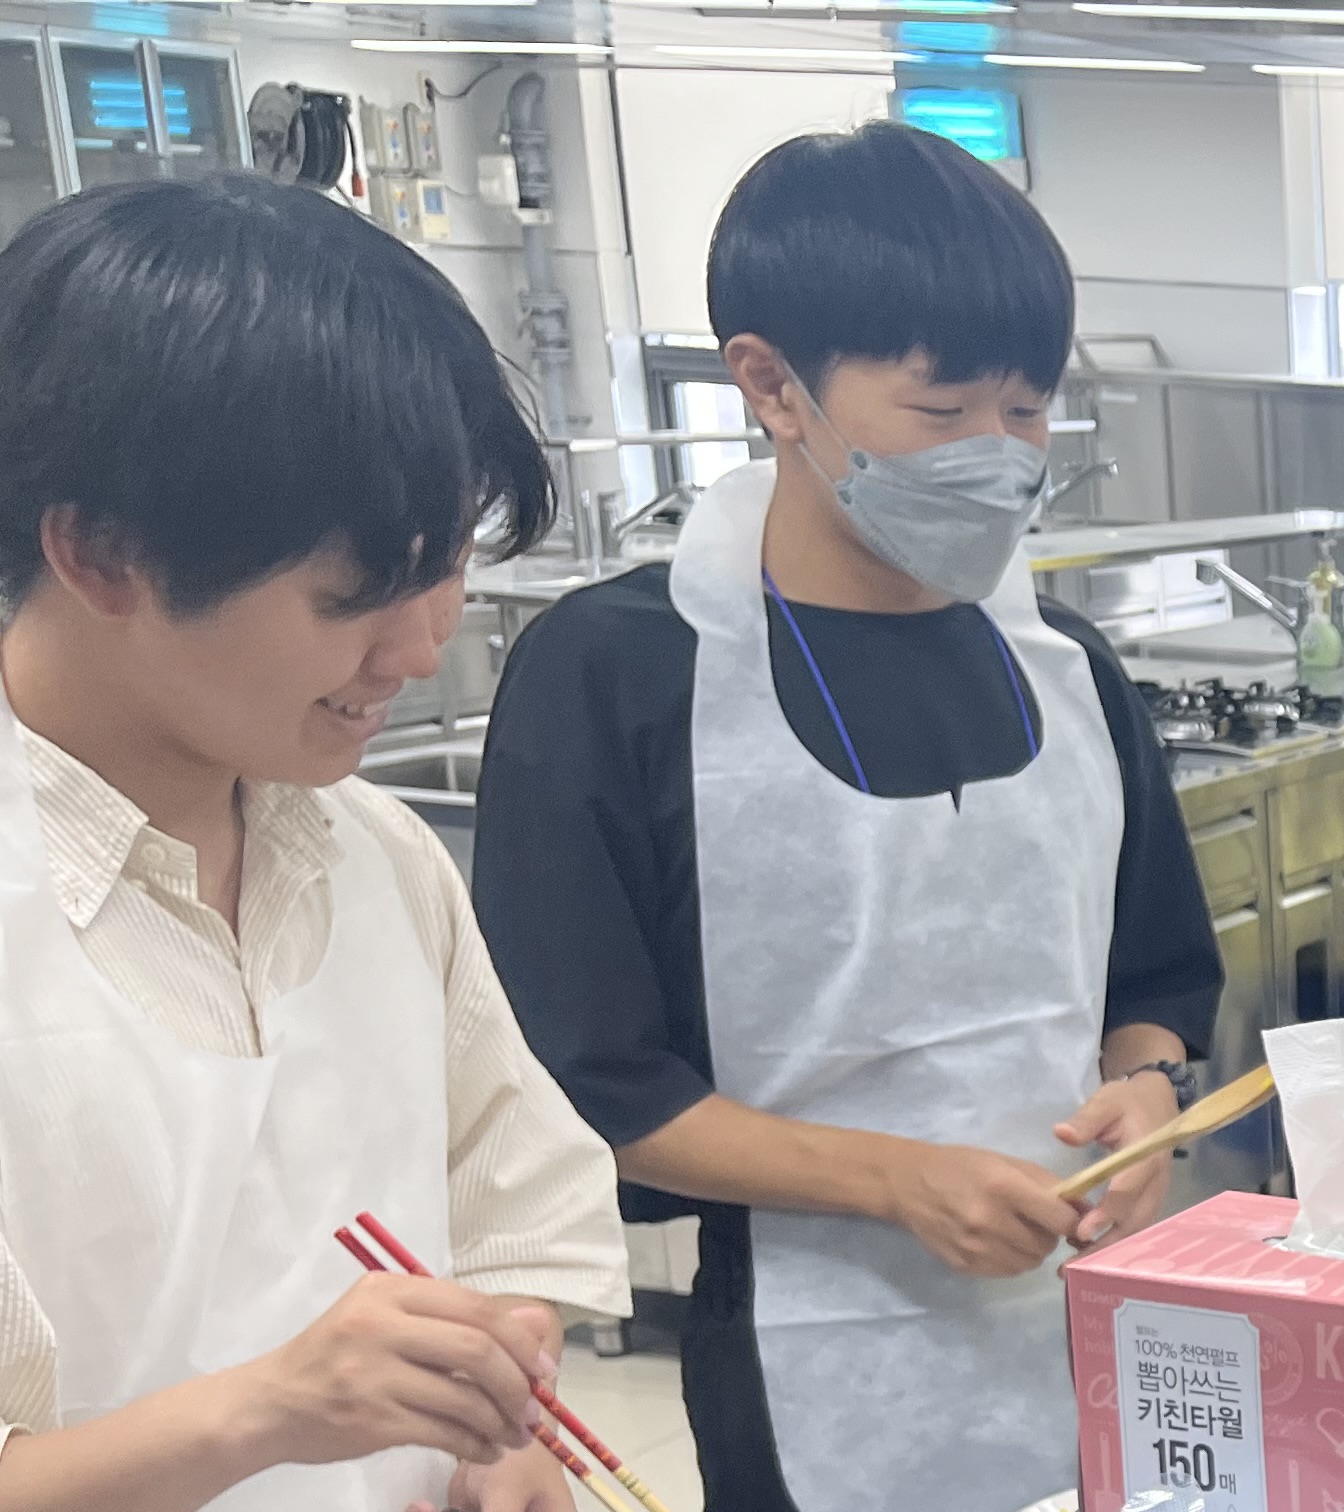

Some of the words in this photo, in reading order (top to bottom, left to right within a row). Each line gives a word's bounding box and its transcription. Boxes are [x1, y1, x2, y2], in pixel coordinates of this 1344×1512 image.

[1135, 1339, 1178, 1360] 100%
[1180, 1343, 1241, 1368] 천연펄프
[1136, 1360, 1242, 1404] 뽑아쓰는
[1137, 1397, 1244, 1440] 키친타월
